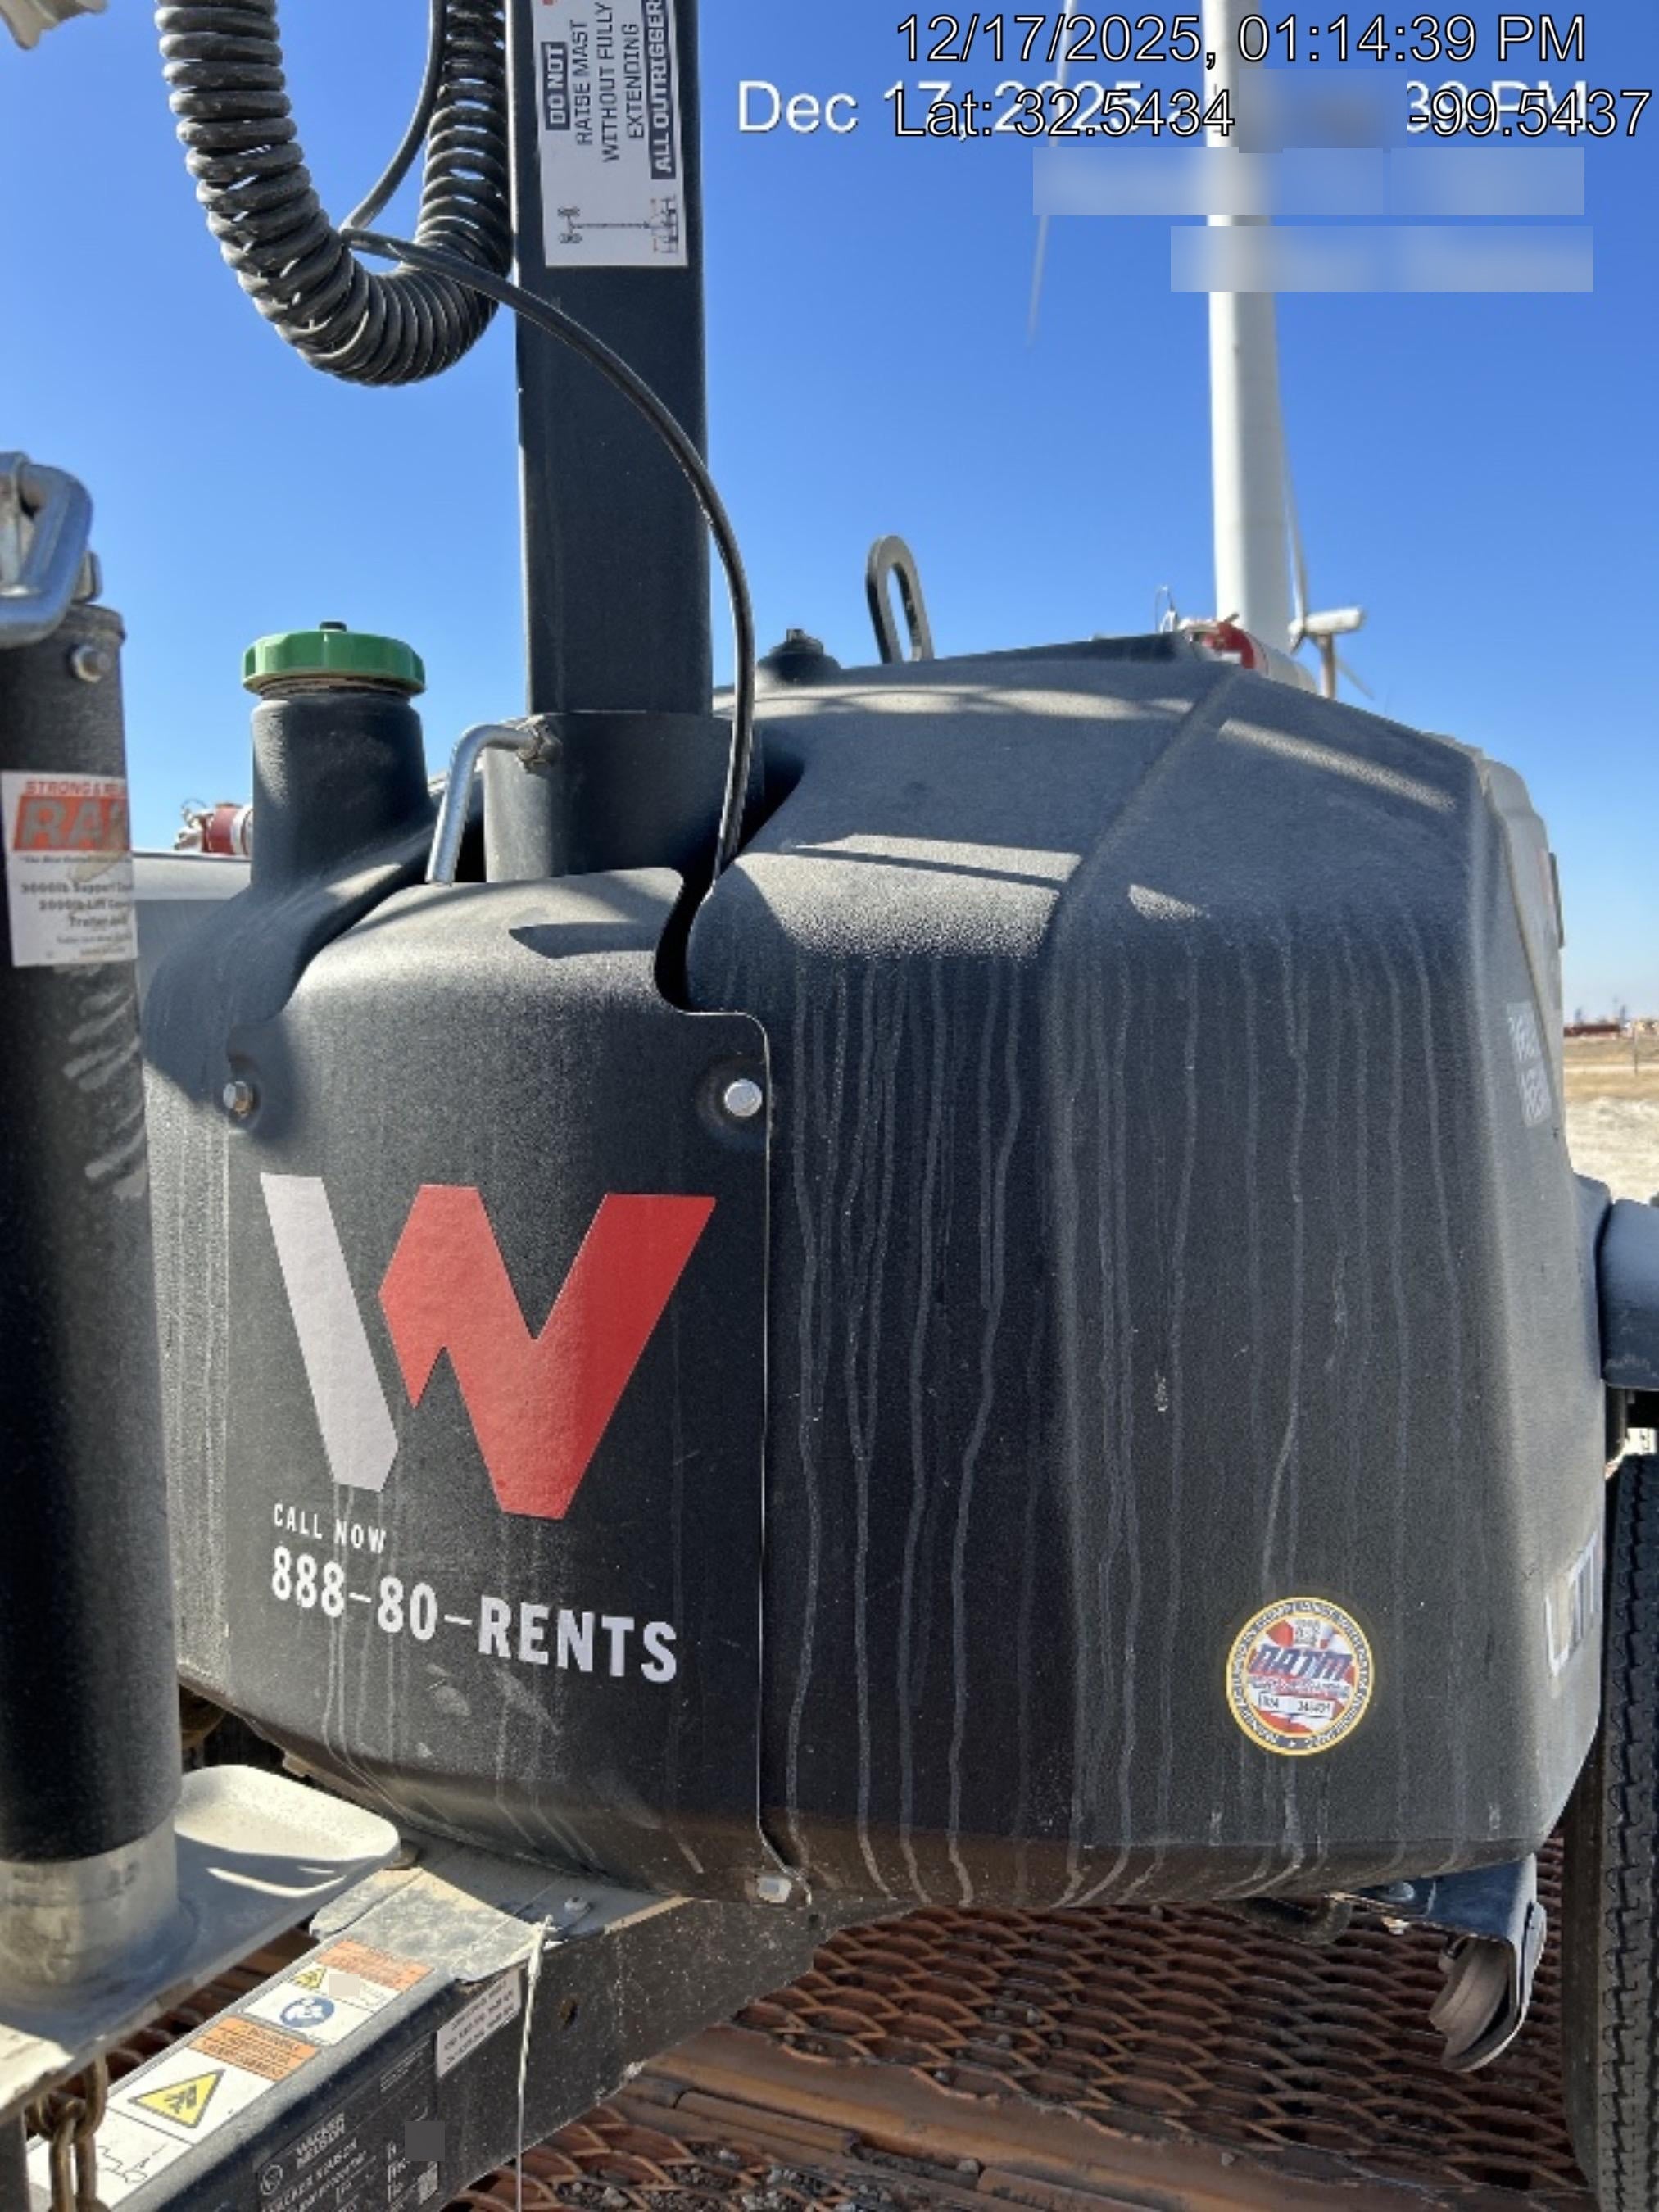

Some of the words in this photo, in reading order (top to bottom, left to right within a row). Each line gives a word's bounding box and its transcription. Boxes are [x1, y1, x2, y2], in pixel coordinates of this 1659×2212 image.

[570, 19, 589, 77] MAST
[595, 2, 615, 60] FULLY
[546, 44, 565, 89] NOT
[622, 23, 645, 139] EXTENDING
[549, 94, 566, 124] DO
[573, 83, 592, 146] RAISE
[599, 66, 619, 162] WITHOUT
[655, 133, 672, 173] ALL
[274, 1503, 324, 1540] CALL
[333, 1518, 388, 1555] NOW
[271, 1545, 678, 1683] 888-80-RENTS
